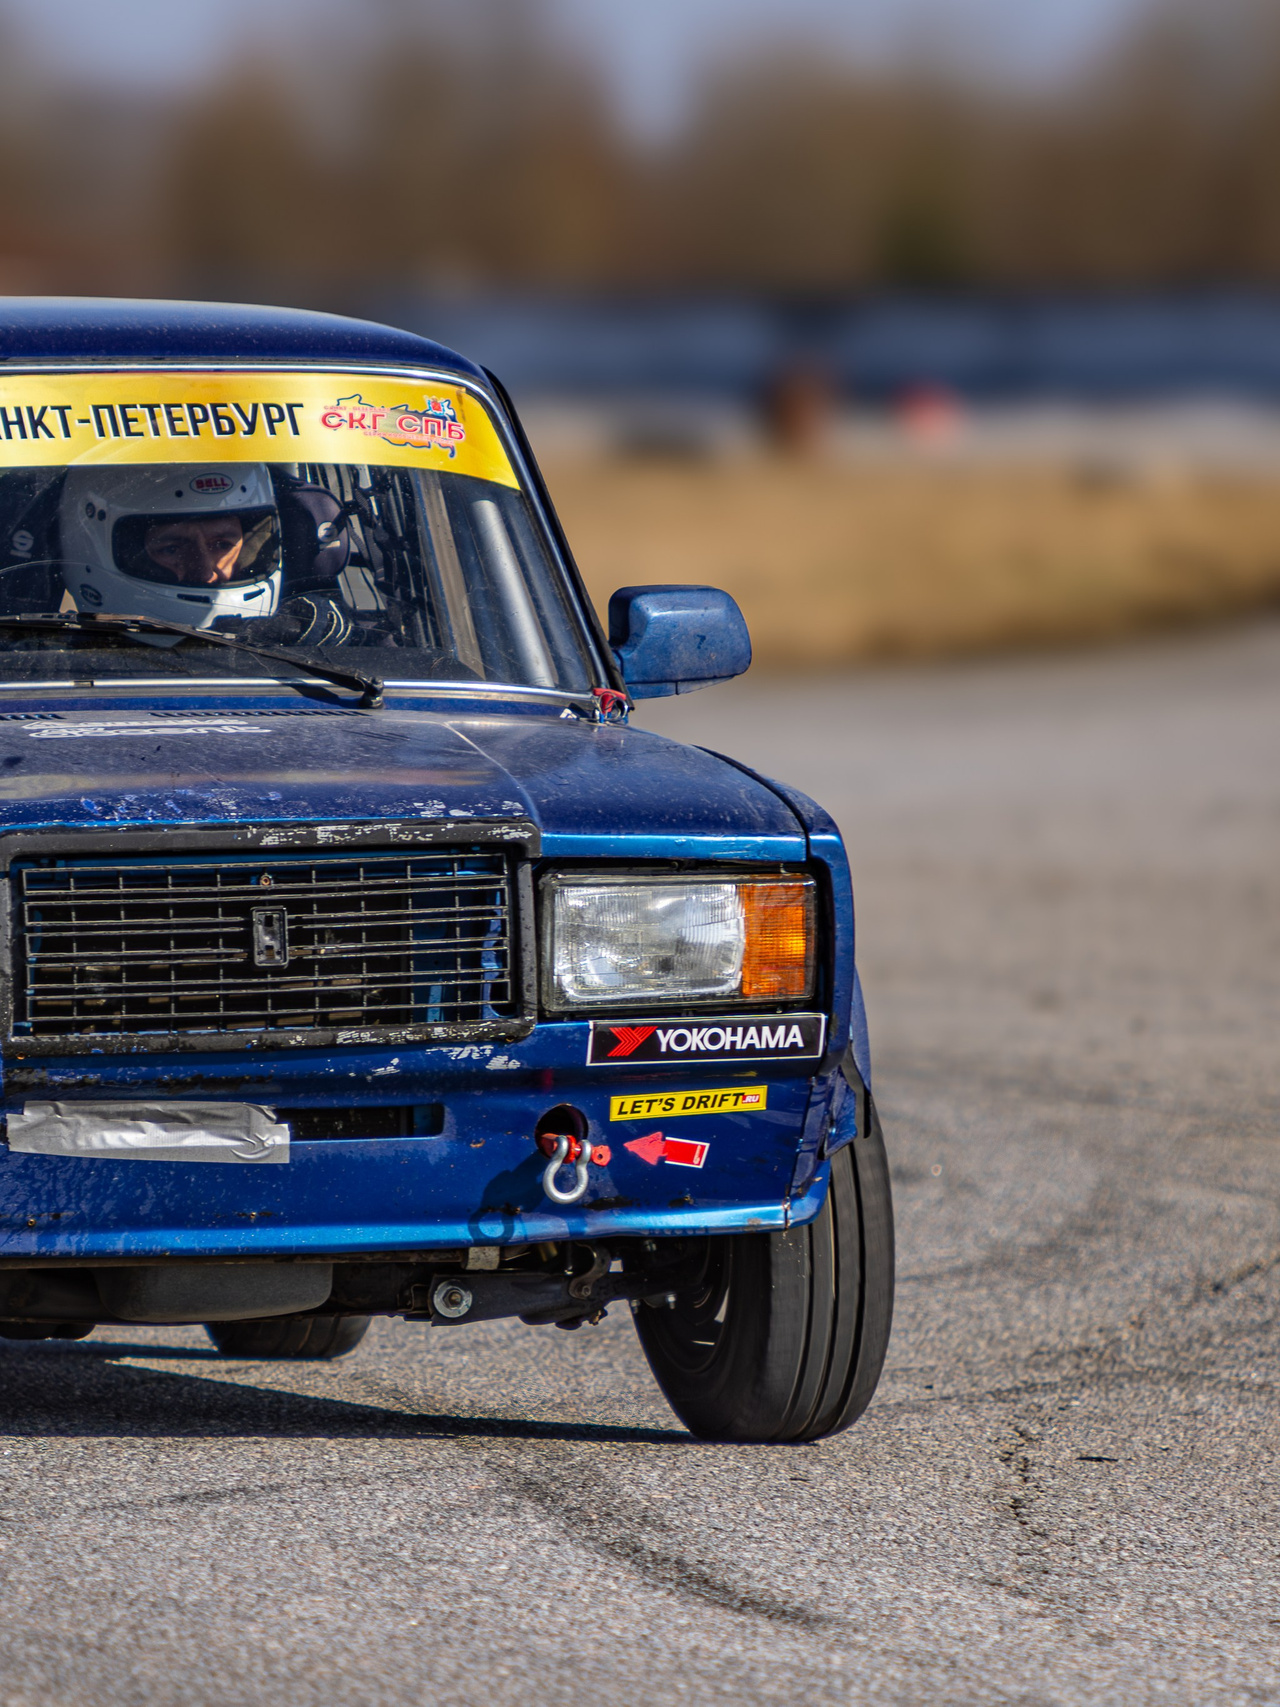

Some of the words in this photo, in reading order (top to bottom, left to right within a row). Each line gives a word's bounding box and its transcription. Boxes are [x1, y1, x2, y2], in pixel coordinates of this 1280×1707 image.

[320, 411, 387, 431] СКГ
[396, 414, 466, 441] СПБ
[655, 1024, 804, 1052] YOKOHAMA
[617, 1097, 676, 1116] LET'S
